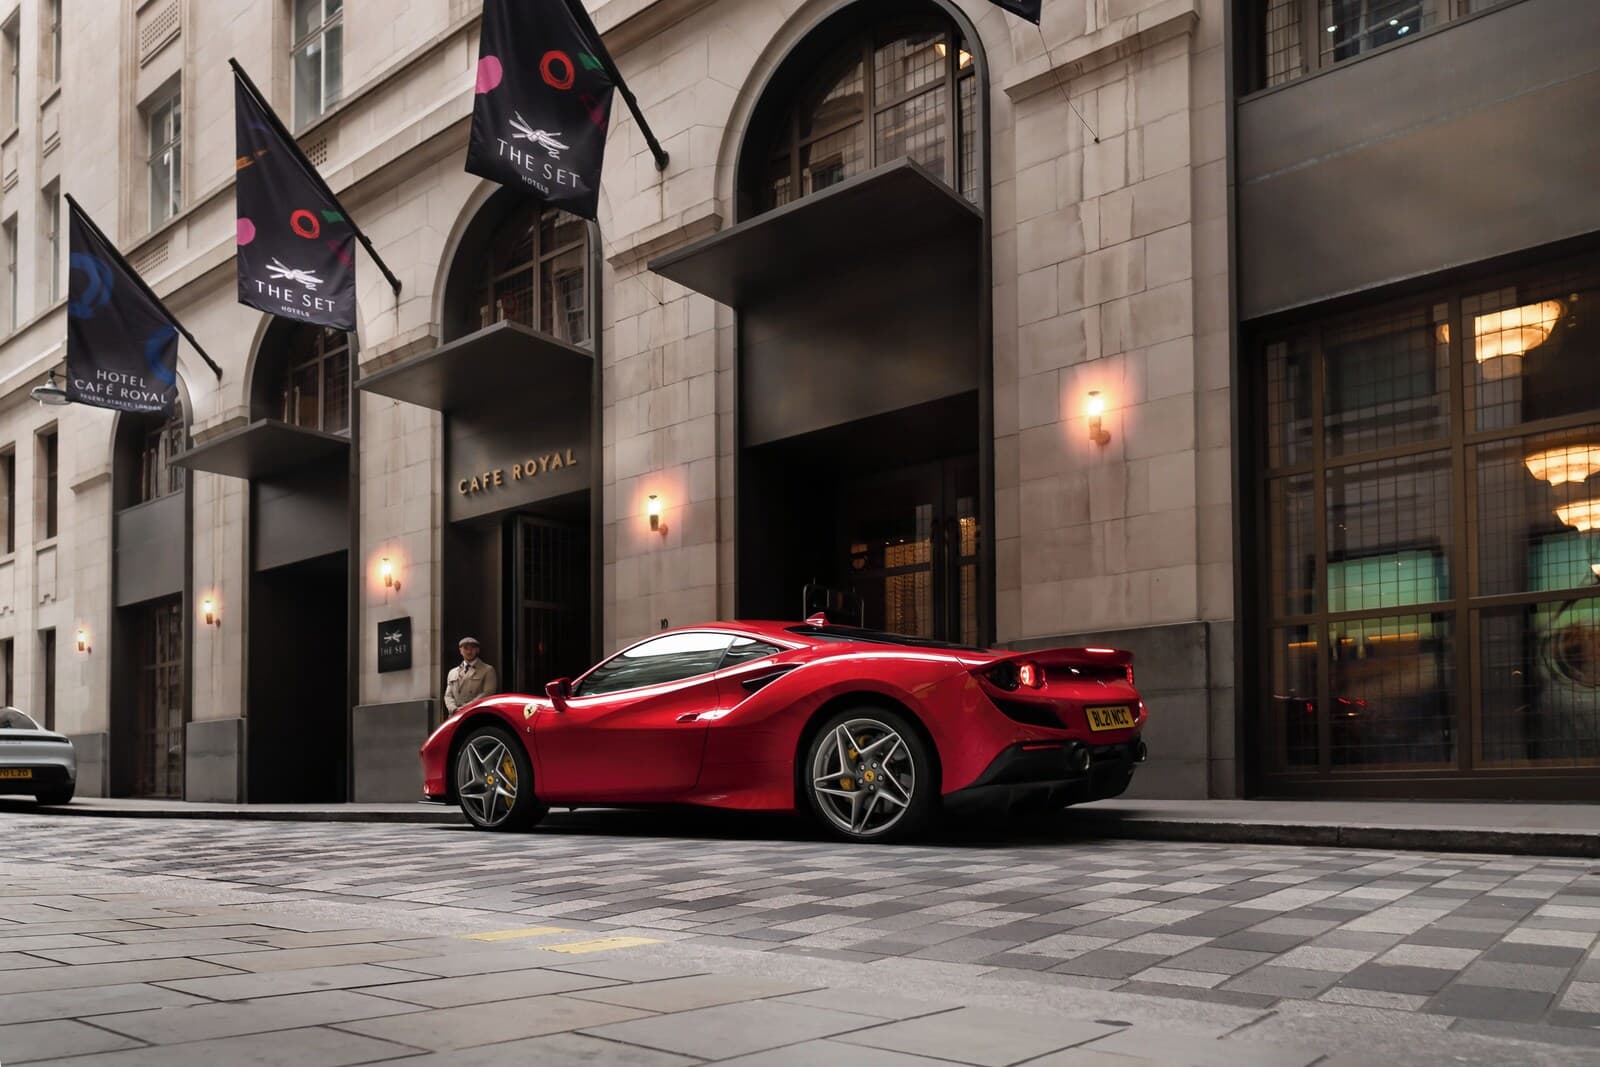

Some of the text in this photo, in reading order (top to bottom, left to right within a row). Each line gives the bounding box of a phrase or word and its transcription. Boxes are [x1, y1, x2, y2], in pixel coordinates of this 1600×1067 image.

[497, 138, 580, 188] THE SET
[521, 175, 549, 194] HOTELS
[255, 280, 335, 312] THE SET
[281, 306, 310, 317] HOTELS
[96, 369, 146, 388] HOTEL
[74, 379, 168, 404] CAFÉ ROYAL
[458, 448, 577, 495] CAFE ROYAL
